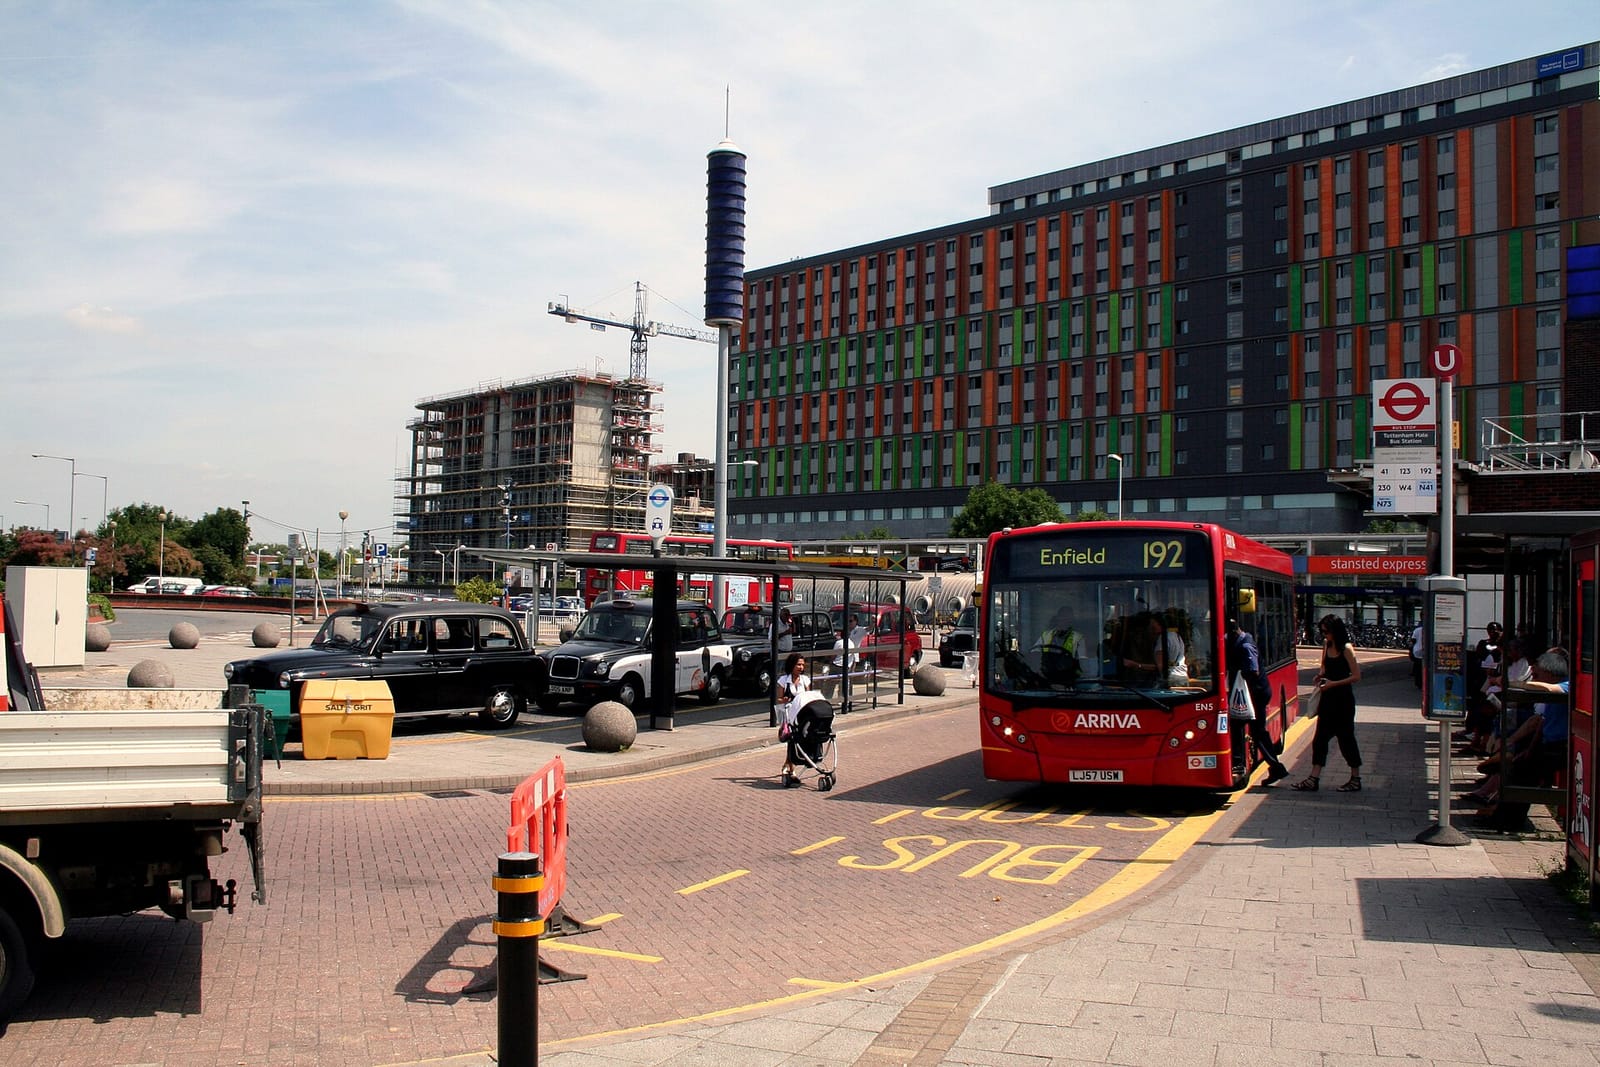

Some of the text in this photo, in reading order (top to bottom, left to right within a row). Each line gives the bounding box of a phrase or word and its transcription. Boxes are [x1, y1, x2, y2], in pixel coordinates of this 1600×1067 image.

[1434, 349, 1455, 371] U
[1420, 467, 1432, 475] 192
[1376, 500, 1392, 508] N73
[376, 544, 385, 556] P
[1040, 540, 1184, 569] Enfield 192
[1330, 557, 1426, 573] stansted express
[1195, 703, 1213, 711] EN5
[1074, 713, 1141, 729] ARRIVA
[1072, 771, 1119, 780] LJ57 USW
[838, 835, 1103, 884] BUS
